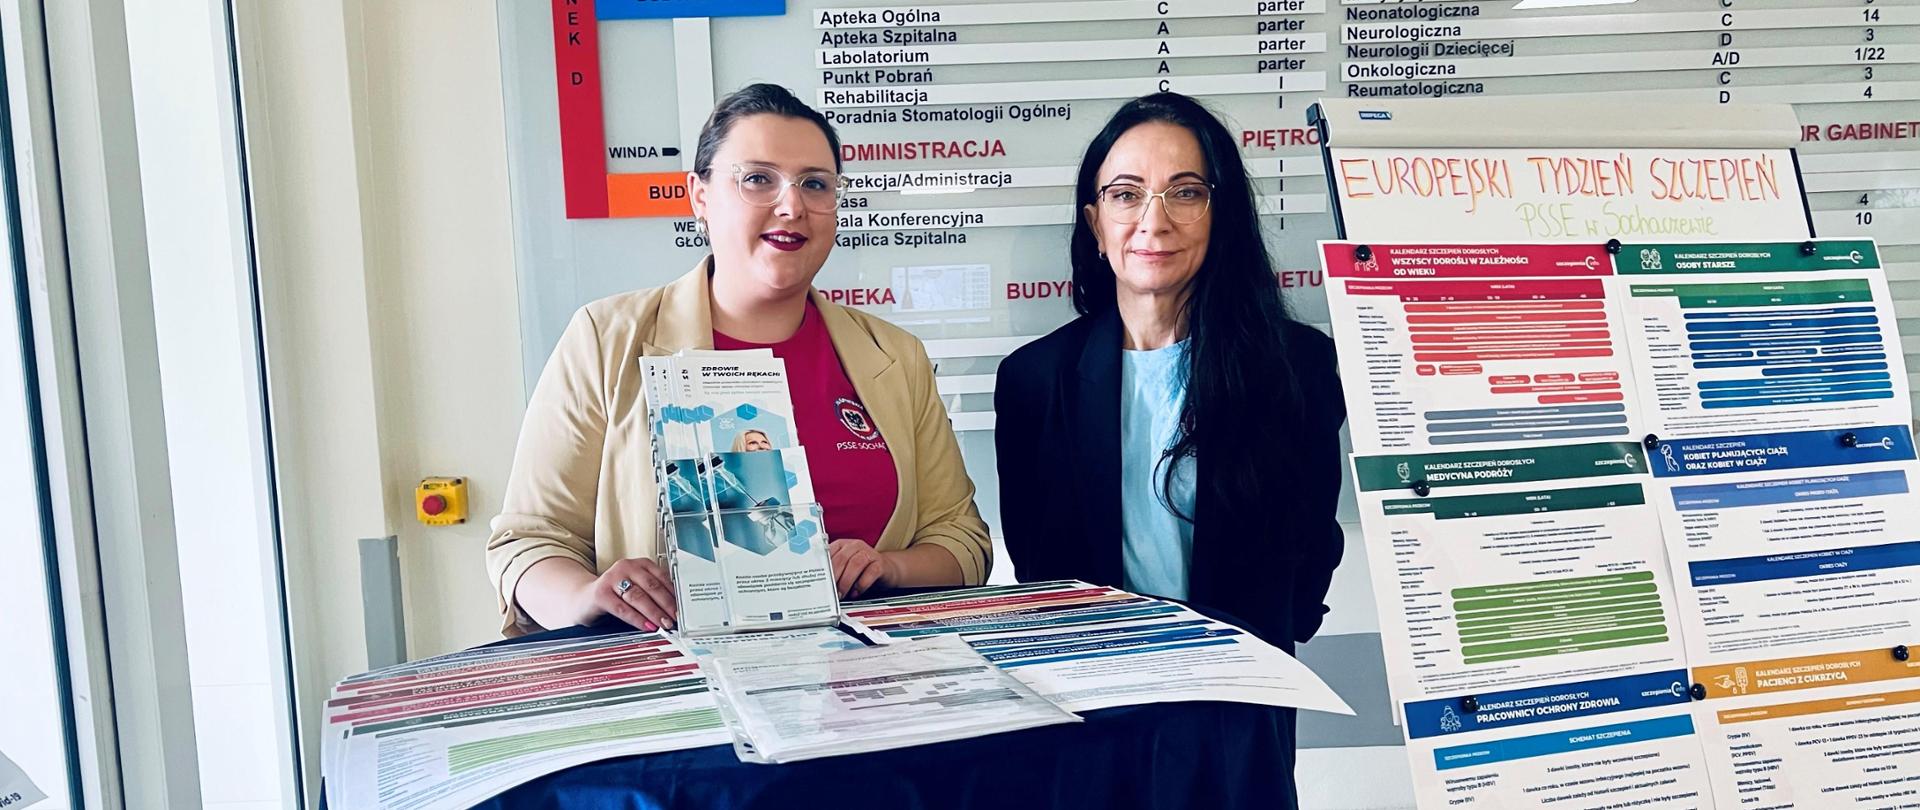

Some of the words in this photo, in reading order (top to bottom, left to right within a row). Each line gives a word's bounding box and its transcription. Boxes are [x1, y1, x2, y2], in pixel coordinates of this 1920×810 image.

[1157, 2, 1169, 15] C
[1257, 0, 1304, 15] parter
[1347, 4, 1480, 22] Neonatologiczna
[820, 11, 877, 27] Apteka
[882, 9, 941, 26] Ogólna
[1721, 14, 1733, 26] C
[1863, 9, 1880, 22] 14
[1158, 21, 1170, 35] A
[1257, 18, 1305, 34] parter
[1347, 25, 1461, 41] Neurologiczna
[821, 31, 878, 47] Apteka
[883, 28, 957, 46] Szpitalna
[1721, 33, 1732, 46] D
[1866, 29, 1874, 42] 3
[1158, 41, 1170, 55] A
[1258, 38, 1306, 53] parter
[1347, 43, 1429, 60] Neurologii
[1434, 40, 1515, 57] Dziecięcej
[822, 49, 929, 65] Labolatorium
[1712, 52, 1740, 66] A/D
[1854, 47, 1885, 61] 1/22
[1158, 61, 1170, 74] A
[1258, 58, 1306, 73] parter
[1348, 63, 1456, 79] Onkologiczna
[571, 72, 583, 85] D
[823, 70, 870, 85] Punkt
[875, 68, 933, 84] Pobrań
[1720, 71, 1731, 85] C
[1865, 67, 1873, 80] 3
[1158, 80, 1170, 93] C
[1348, 80, 1484, 98] Reumatologiczna
[1863, 85, 1873, 99] 4
[824, 89, 928, 105] Rehabilitacja
[1719, 91, 1730, 104] D
[825, 109, 897, 125] Poradnia
[902, 106, 1003, 123] Stomatologii
[1008, 104, 1071, 122] Ogólnej
[608, 146, 658, 158] WINDA
[841, 139, 1006, 163] DMINISTRACJA
[1339, 157, 1513, 214] EUROPEJSKI
[1527, 152, 1634, 196] TYDZIEŃ
[1651, 152, 1780, 202] SZCZEPIEŃ
[841, 197, 868, 209] asa
[1860, 193, 1869, 206] 4
[868, 212, 984, 229] Konferencyjna
[1515, 203, 1579, 238] PSSE
[1602, 204, 1719, 237] Sochaczewie
[1855, 212, 1873, 225] 10
[894, 230, 967, 247] Szpitalna
[1433, 256, 1468, 265] DOROŚLI
[1479, 255, 1528, 265] ZALEŻNOŚCI
[1676, 261, 1702, 269] OSOBY
[1703, 261, 1736, 269] STARSZE
[1393, 268, 1407, 276] OD
[1407, 268, 1435, 276] WIEKU
[1683, 452, 1710, 460] KOBIET
[1711, 448, 1766, 459] PLANUJĄCYCH
[1766, 446, 1788, 456] CIĄŻĘ
[1423, 462, 1463, 471] KALENDARZ
[1707, 460, 1734, 469] KOBIET
[1745, 457, 1767, 467] CIĄŻY
[1426, 471, 1473, 481] MEDYCYNA
[1474, 467, 1513, 479] PODRÓŻY
[1757, 676, 1797, 688] PACJENCI
[1804, 671, 1848, 683] CUKRZYCĄ
[1477, 701, 1514, 711] ALENDARZ
[1514, 696, 1550, 707] SZCZEPIEŃ
[1550, 691, 1589, 703] DOROSŁYCH
[1476, 709, 1535, 724] PRACOWNICY
[1536, 703, 1578, 716] OCHRONY
[1579, 697, 1620, 711] ZDROWIA
